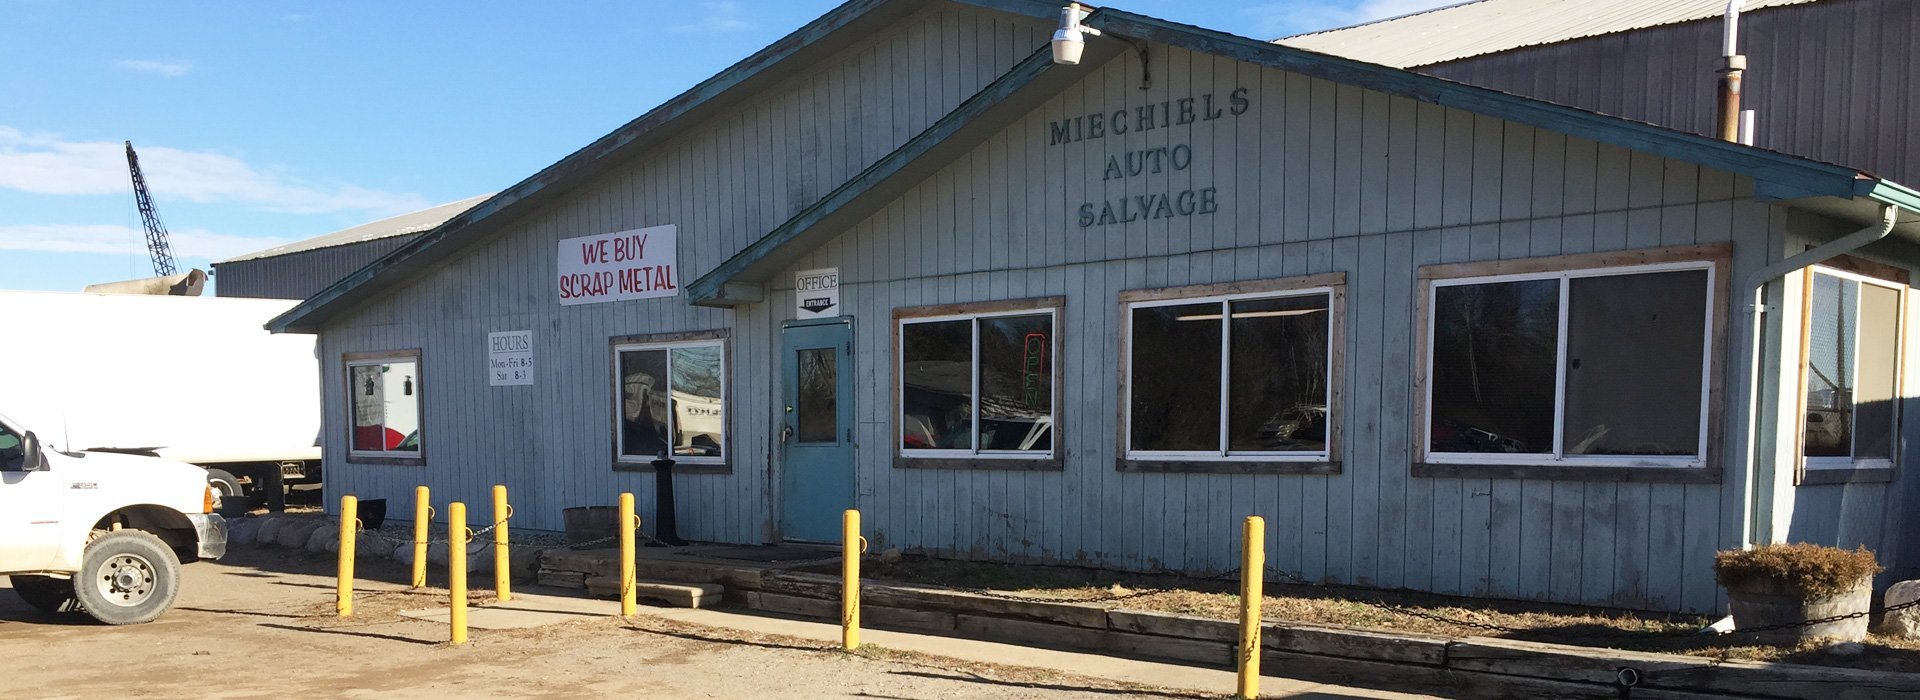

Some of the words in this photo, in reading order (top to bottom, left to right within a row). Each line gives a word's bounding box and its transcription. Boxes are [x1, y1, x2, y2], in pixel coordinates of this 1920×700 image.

[1049, 87, 1249, 146] MIECHIELS
[1102, 143, 1192, 181] AUTO
[1078, 186, 1219, 228] SALVAGE
[582, 239, 609, 265] WE
[613, 233, 648, 262] BUY
[560, 271, 614, 299] SCRAP
[618, 264, 677, 294] METAL
[796, 274, 838, 291] OFFICE
[492, 334, 529, 351] HOURS
[496, 370, 508, 381] Sat
[1024, 337, 1040, 407] OPEN
